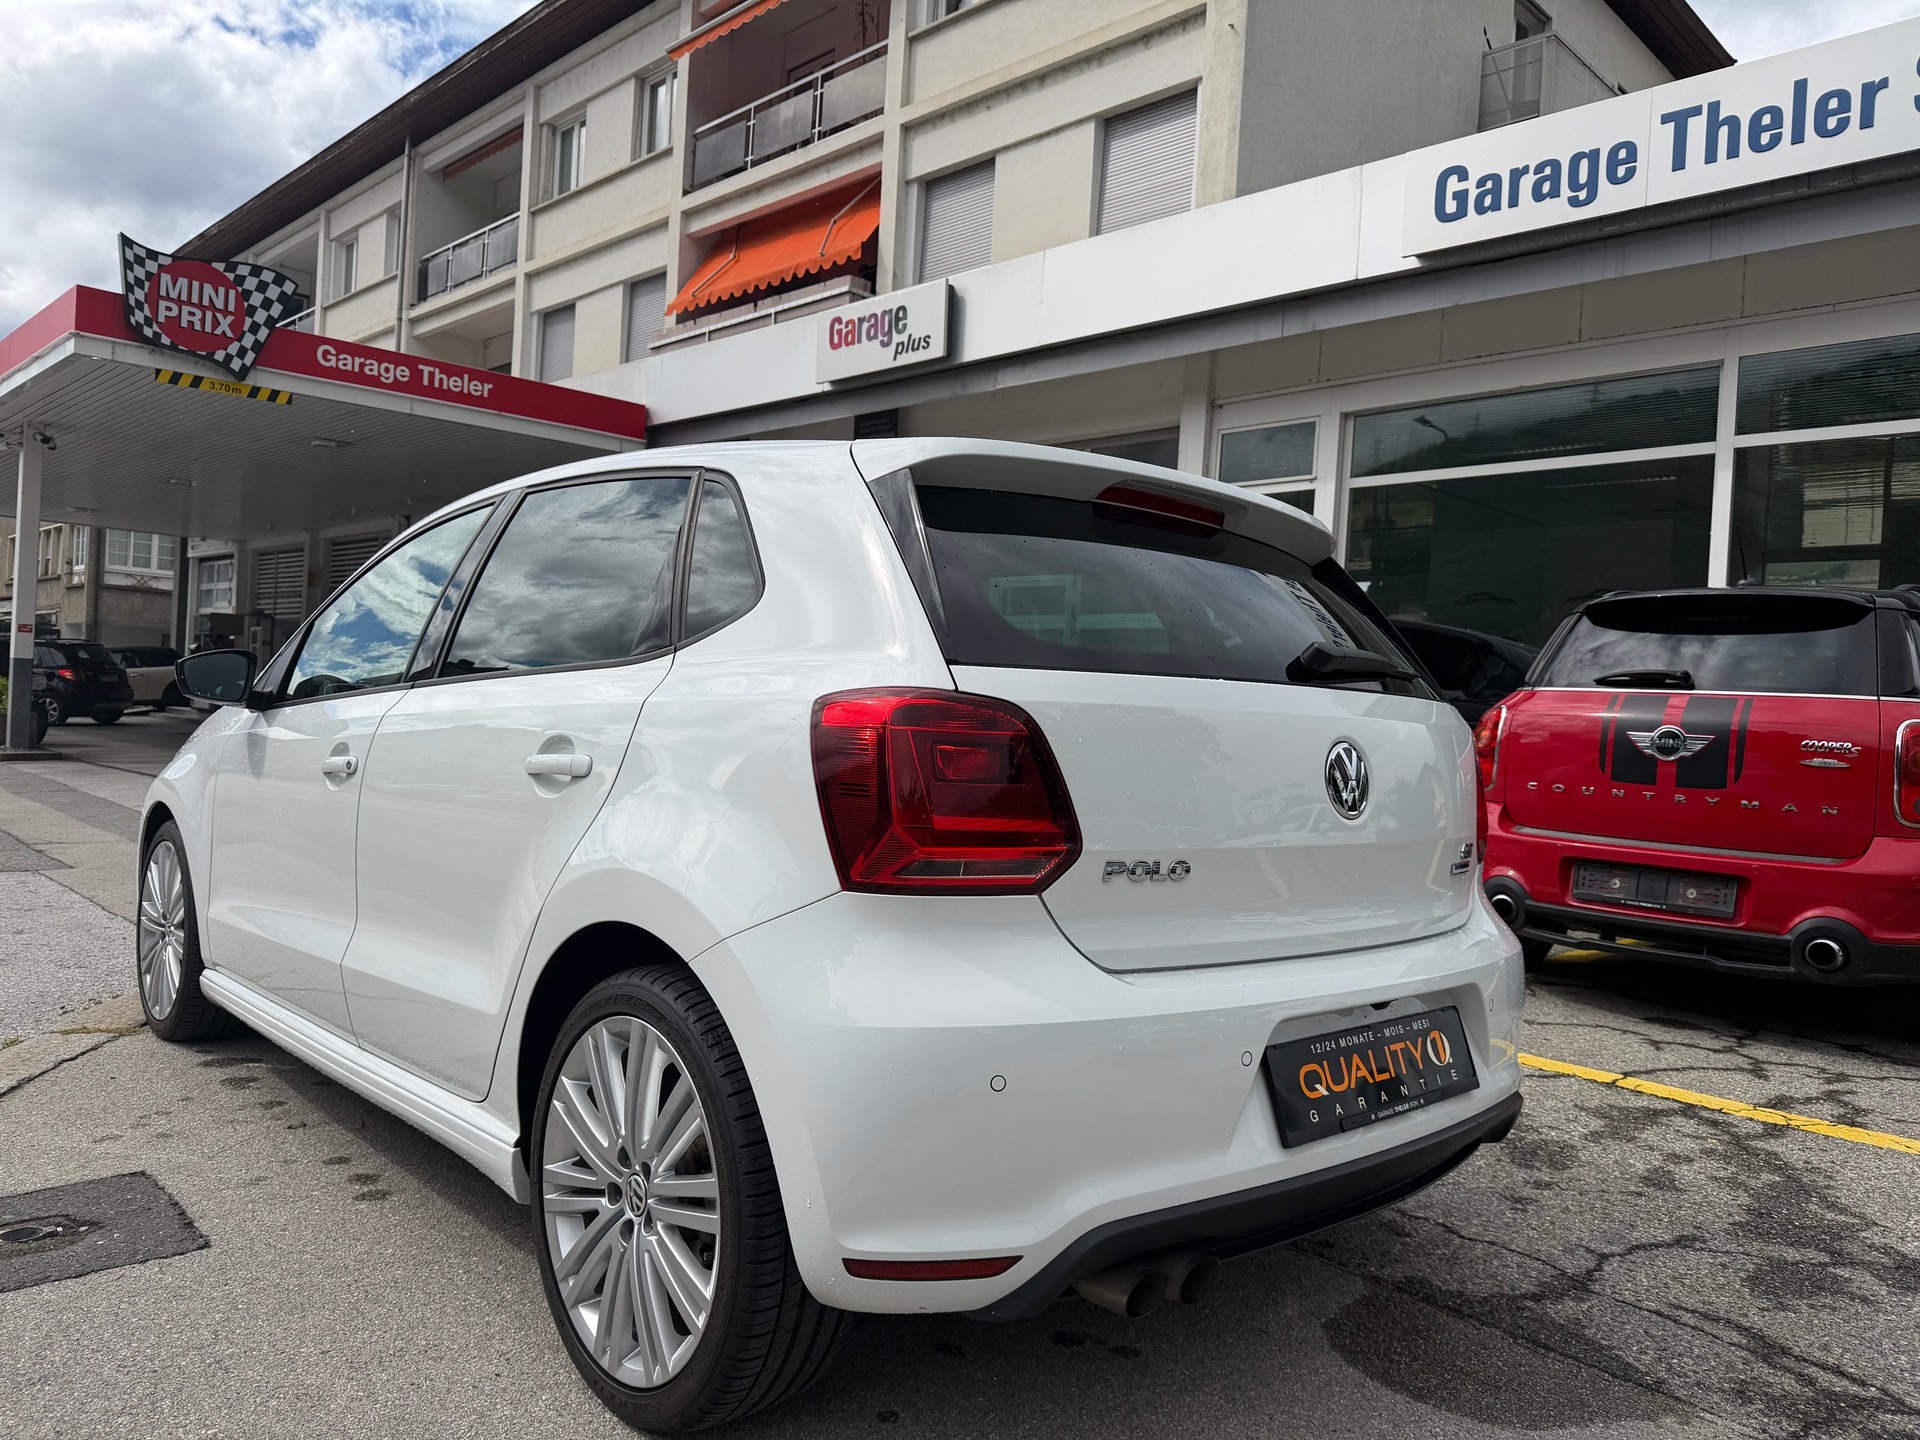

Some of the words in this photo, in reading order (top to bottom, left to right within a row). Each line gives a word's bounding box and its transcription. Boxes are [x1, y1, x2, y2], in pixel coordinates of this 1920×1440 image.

[1434, 140, 1638, 223] Garage
[1660, 76, 1889, 173] Theler
[159, 272, 236, 313] MINI
[157, 300, 235, 339] PRIX
[829, 305, 908, 351] Garage
[892, 333, 931, 361] plus
[316, 344, 410, 384] Garage
[418, 364, 493, 398] Theler
[1656, 737, 1683, 749] MINI
[1800, 740, 1852, 753] COOPER
[1527, 782, 1839, 816] COUNTRYMAN
[1101, 860, 1191, 883] POLO
[1310, 1040, 1336, 1054] 12/24
[1340, 1031, 1374, 1048] MONATE
[1383, 1025, 1404, 1038] MOIS
[1412, 1018, 1430, 1030] MESI
[1299, 1037, 1423, 1099] QUALITY
[1309, 1069, 1458, 1123] GARANTIE
[1377, 1107, 1394, 1119] GARAGE
